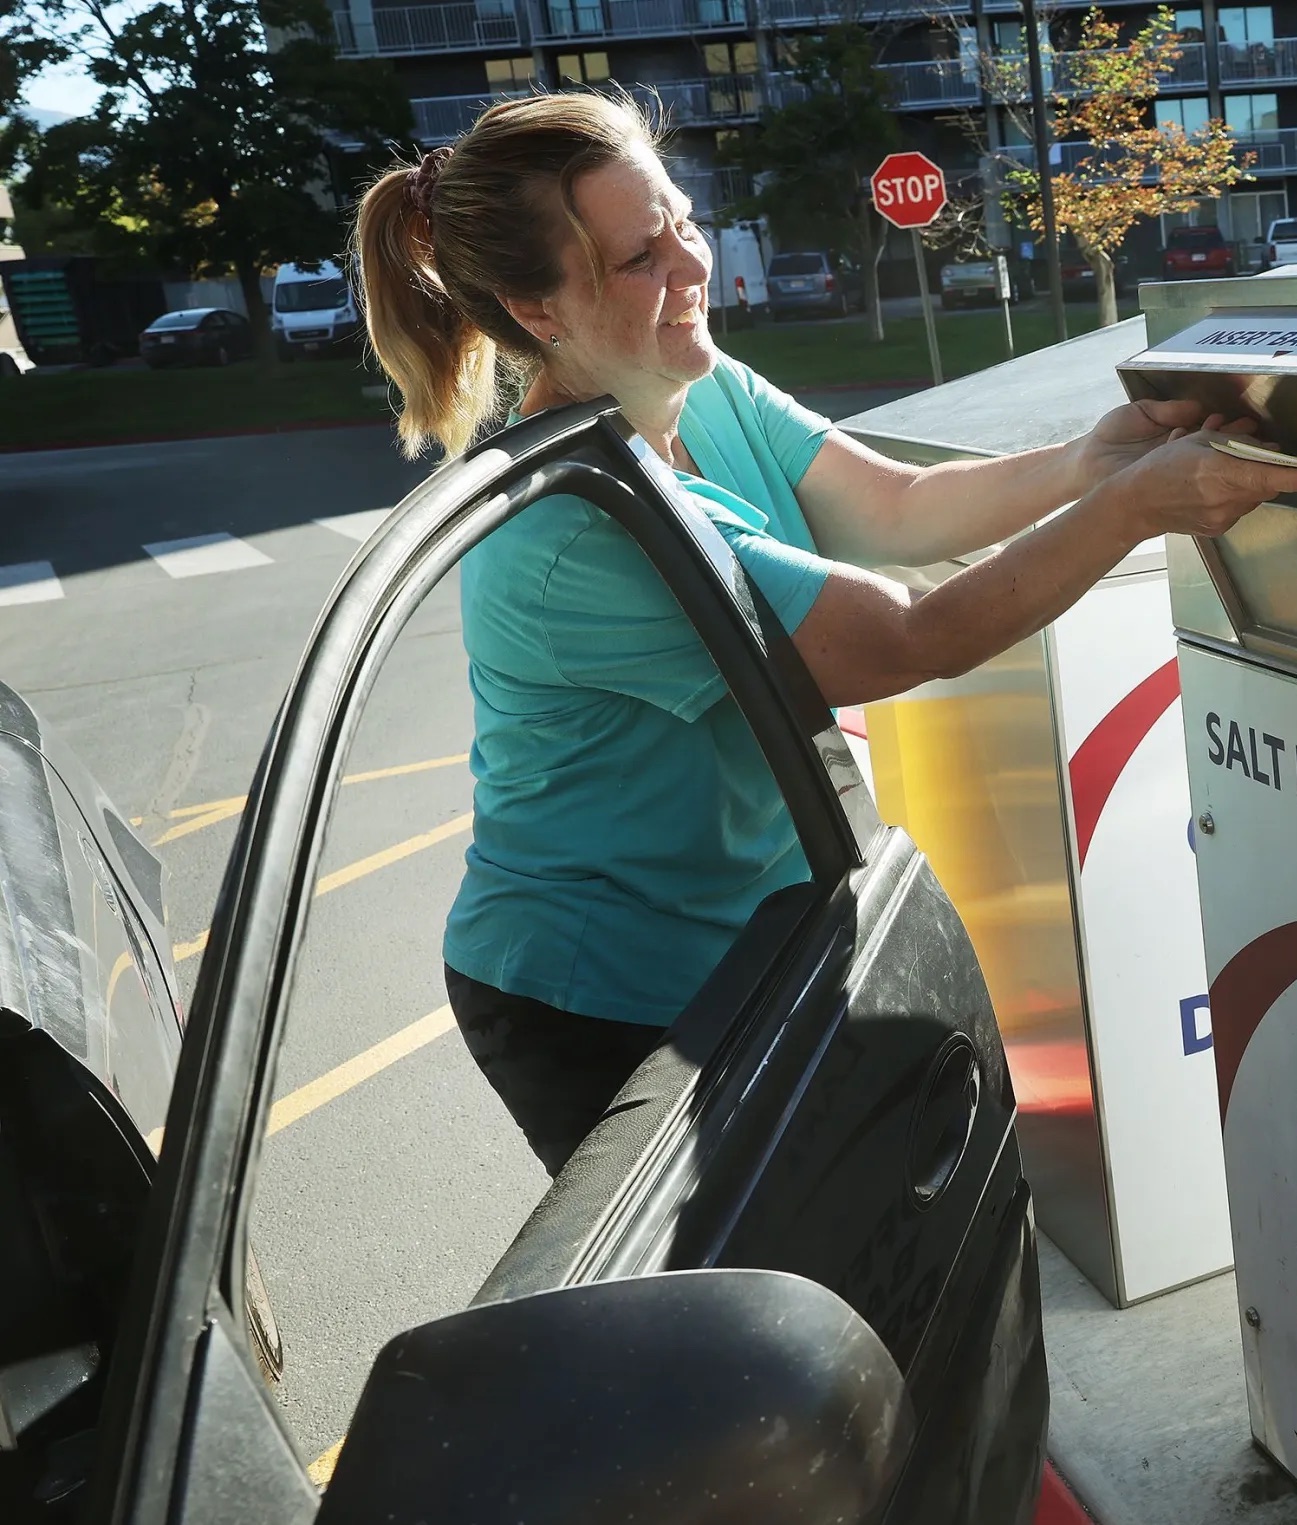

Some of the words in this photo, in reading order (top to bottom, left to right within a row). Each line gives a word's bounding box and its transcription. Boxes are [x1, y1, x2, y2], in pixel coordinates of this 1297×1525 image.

[877, 174, 940, 207] STOP
[1195, 330, 1283, 345] INSERT
[1205, 711, 1285, 791] SALT
